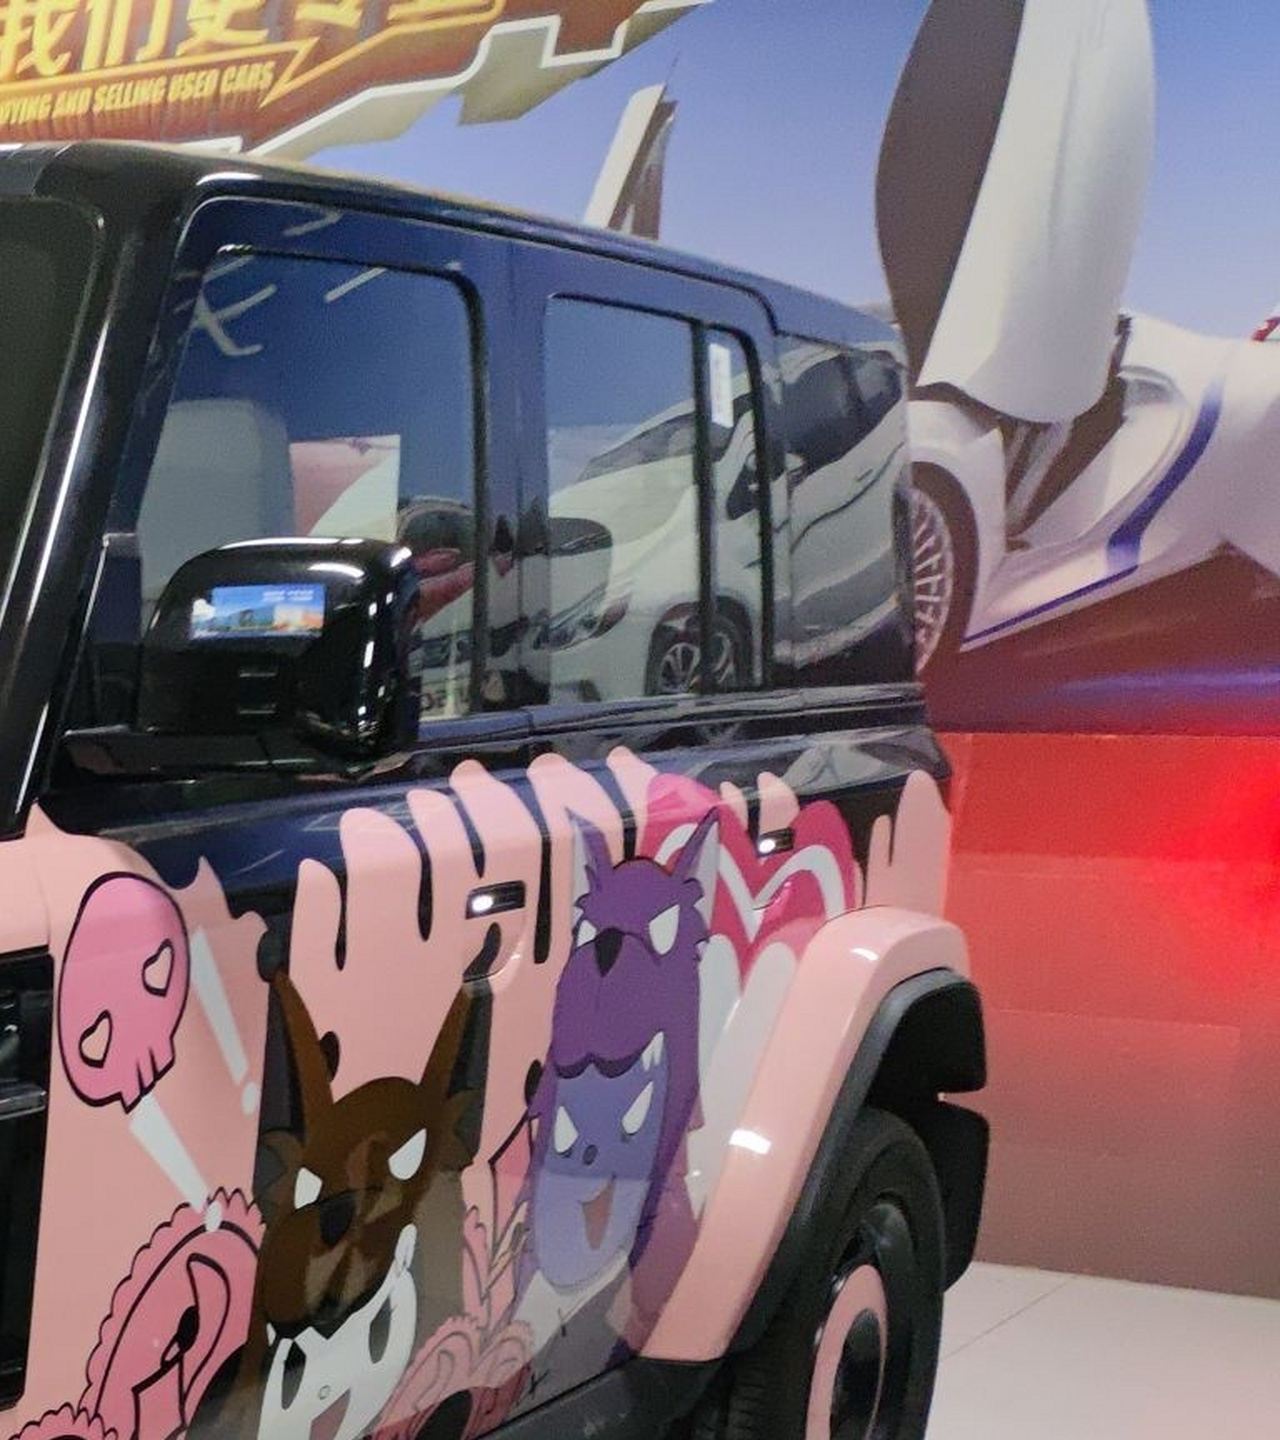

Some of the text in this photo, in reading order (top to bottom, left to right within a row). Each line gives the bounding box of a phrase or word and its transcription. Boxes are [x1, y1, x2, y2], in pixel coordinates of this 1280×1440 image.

[52, 87, 93, 119] AND
[92, 76, 167, 114] SELLING
[167, 68, 219, 102] USED
[219, 60, 276, 94] CARS
